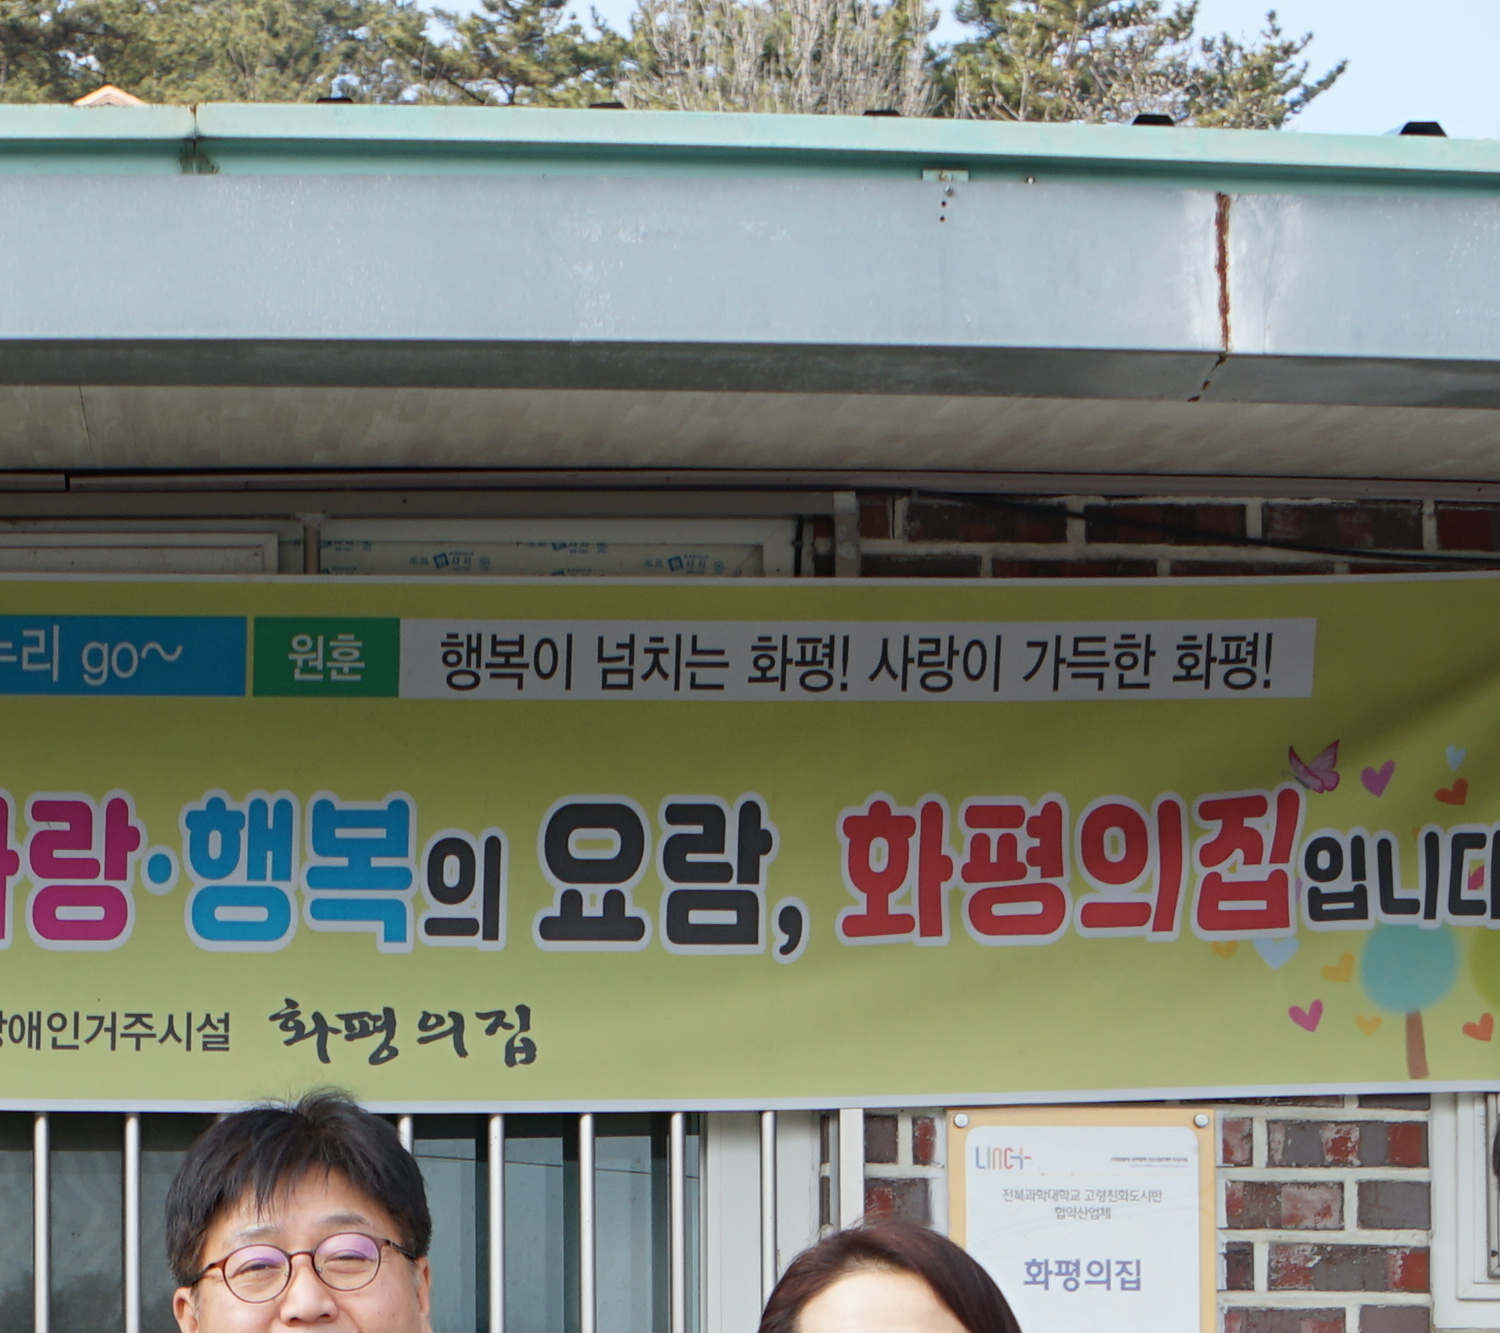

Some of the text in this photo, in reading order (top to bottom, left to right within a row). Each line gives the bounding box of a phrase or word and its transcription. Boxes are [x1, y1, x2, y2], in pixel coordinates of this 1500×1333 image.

[288, 632, 365, 684] 원훈
[438, 631, 1274, 694] 행복이 넘치는 화평! 사랑이 가득한 화평!
[538, 797, 804, 959] 요람,
[269, 996, 538, 1067] 화평의집
[1001, 1188, 1081, 1203] 전북과학대학교
[1023, 1258, 1142, 1292] 화평의집
